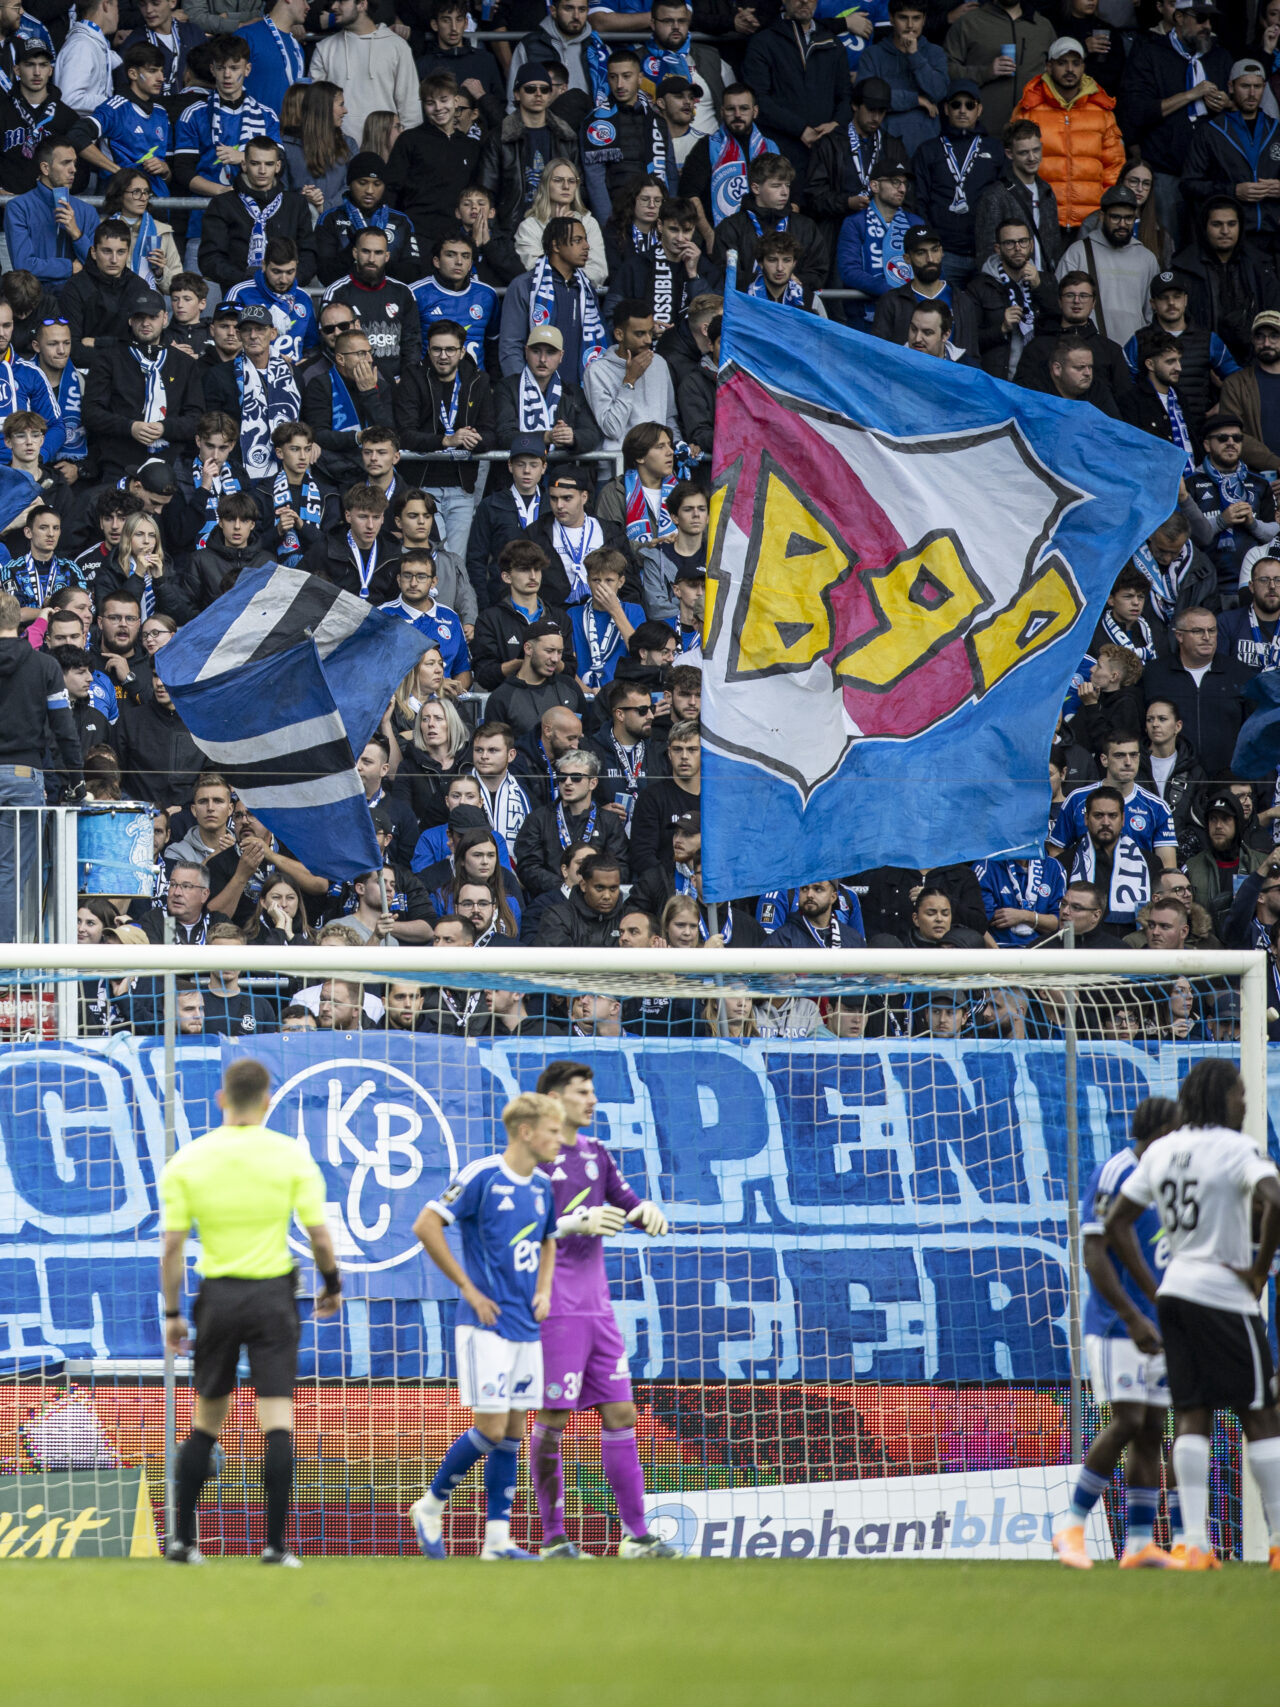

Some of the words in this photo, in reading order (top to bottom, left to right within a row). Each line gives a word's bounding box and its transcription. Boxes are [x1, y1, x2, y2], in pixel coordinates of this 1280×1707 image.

[653, 263, 671, 324] OSSIBLE
[367, 332, 398, 348] ager
[1160, 1179, 1200, 1233] 35
[513, 1239, 542, 1273] es
